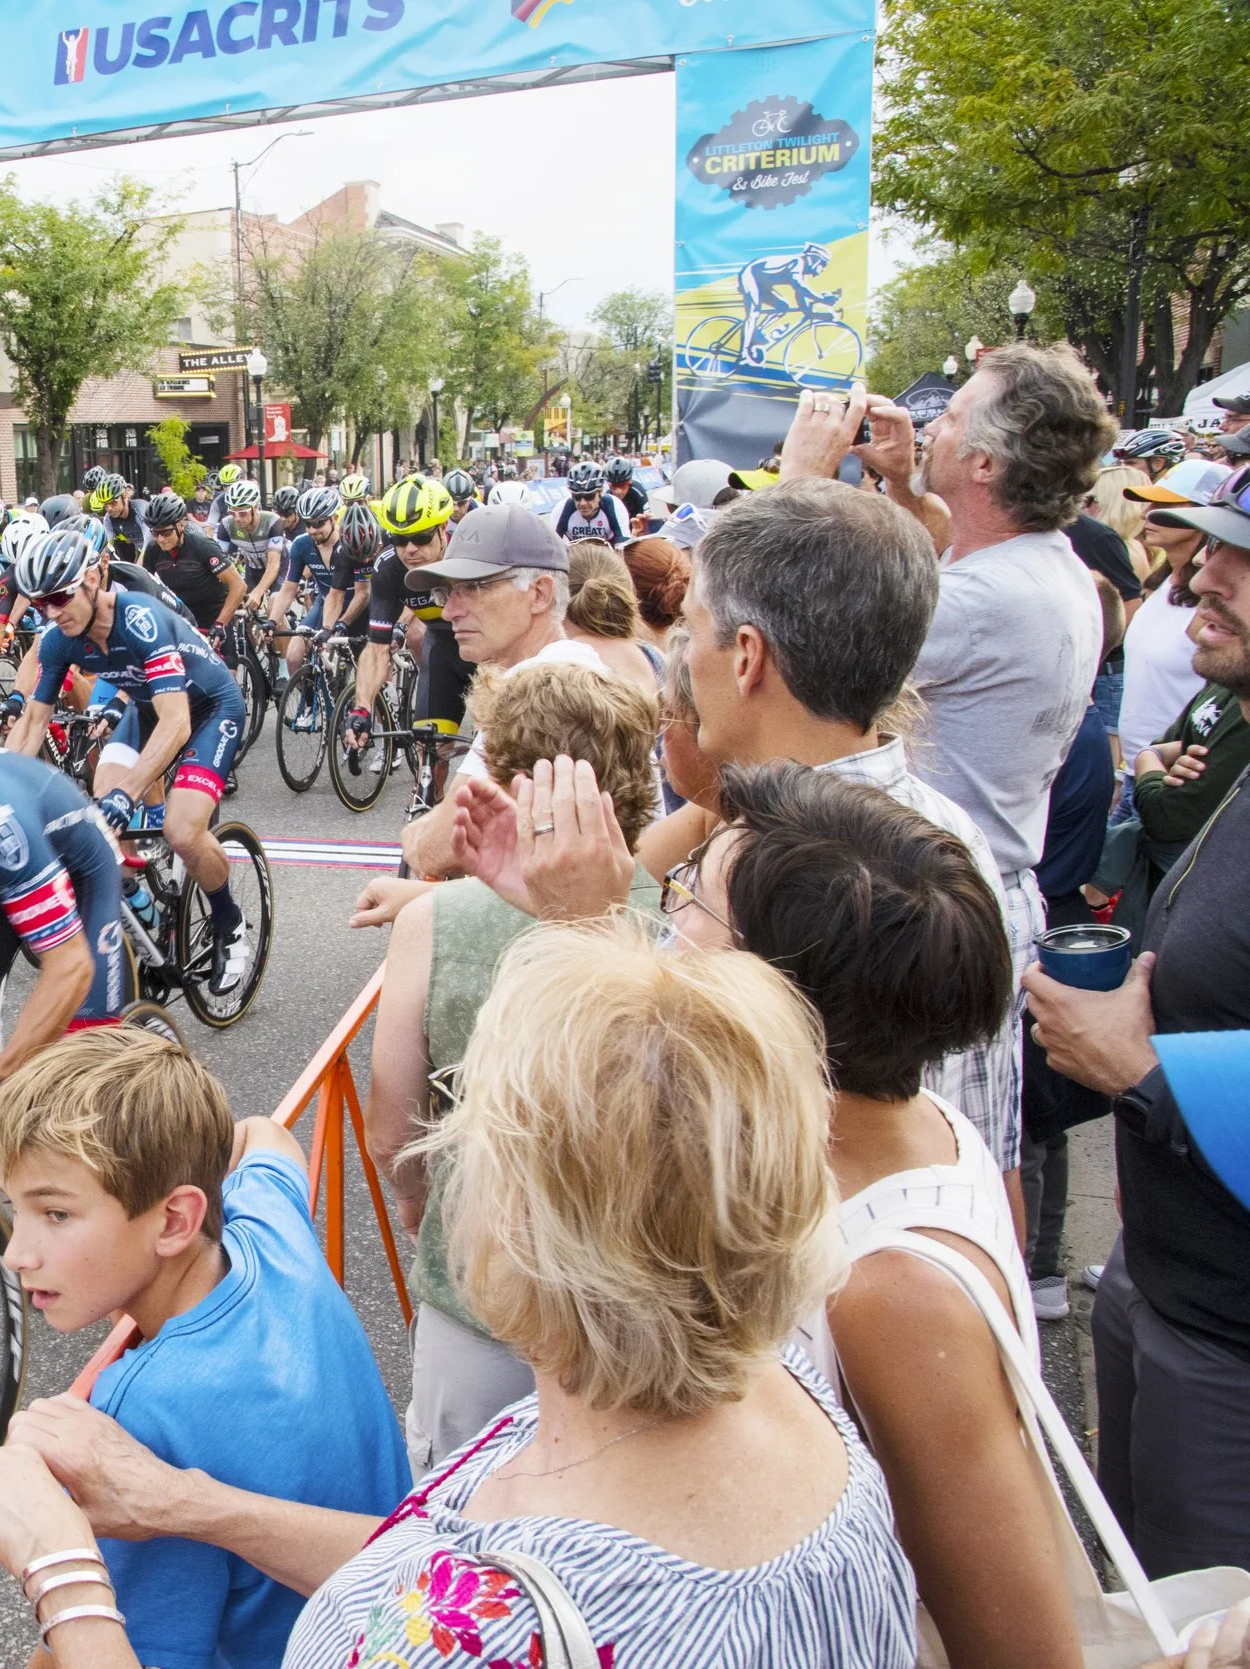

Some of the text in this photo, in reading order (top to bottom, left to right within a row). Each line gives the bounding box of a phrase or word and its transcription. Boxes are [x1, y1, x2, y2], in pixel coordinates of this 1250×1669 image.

[93, 0, 406, 76] USACRITS
[705, 132, 840, 157] LITTLETON TWILIGHT
[704, 143, 840, 175] CRITERIUM
[750, 172, 779, 190] Bike
[781, 170, 810, 186] Fest
[183, 353, 251, 367] THE ALLEY
[572, 526, 602, 536] GREAT
